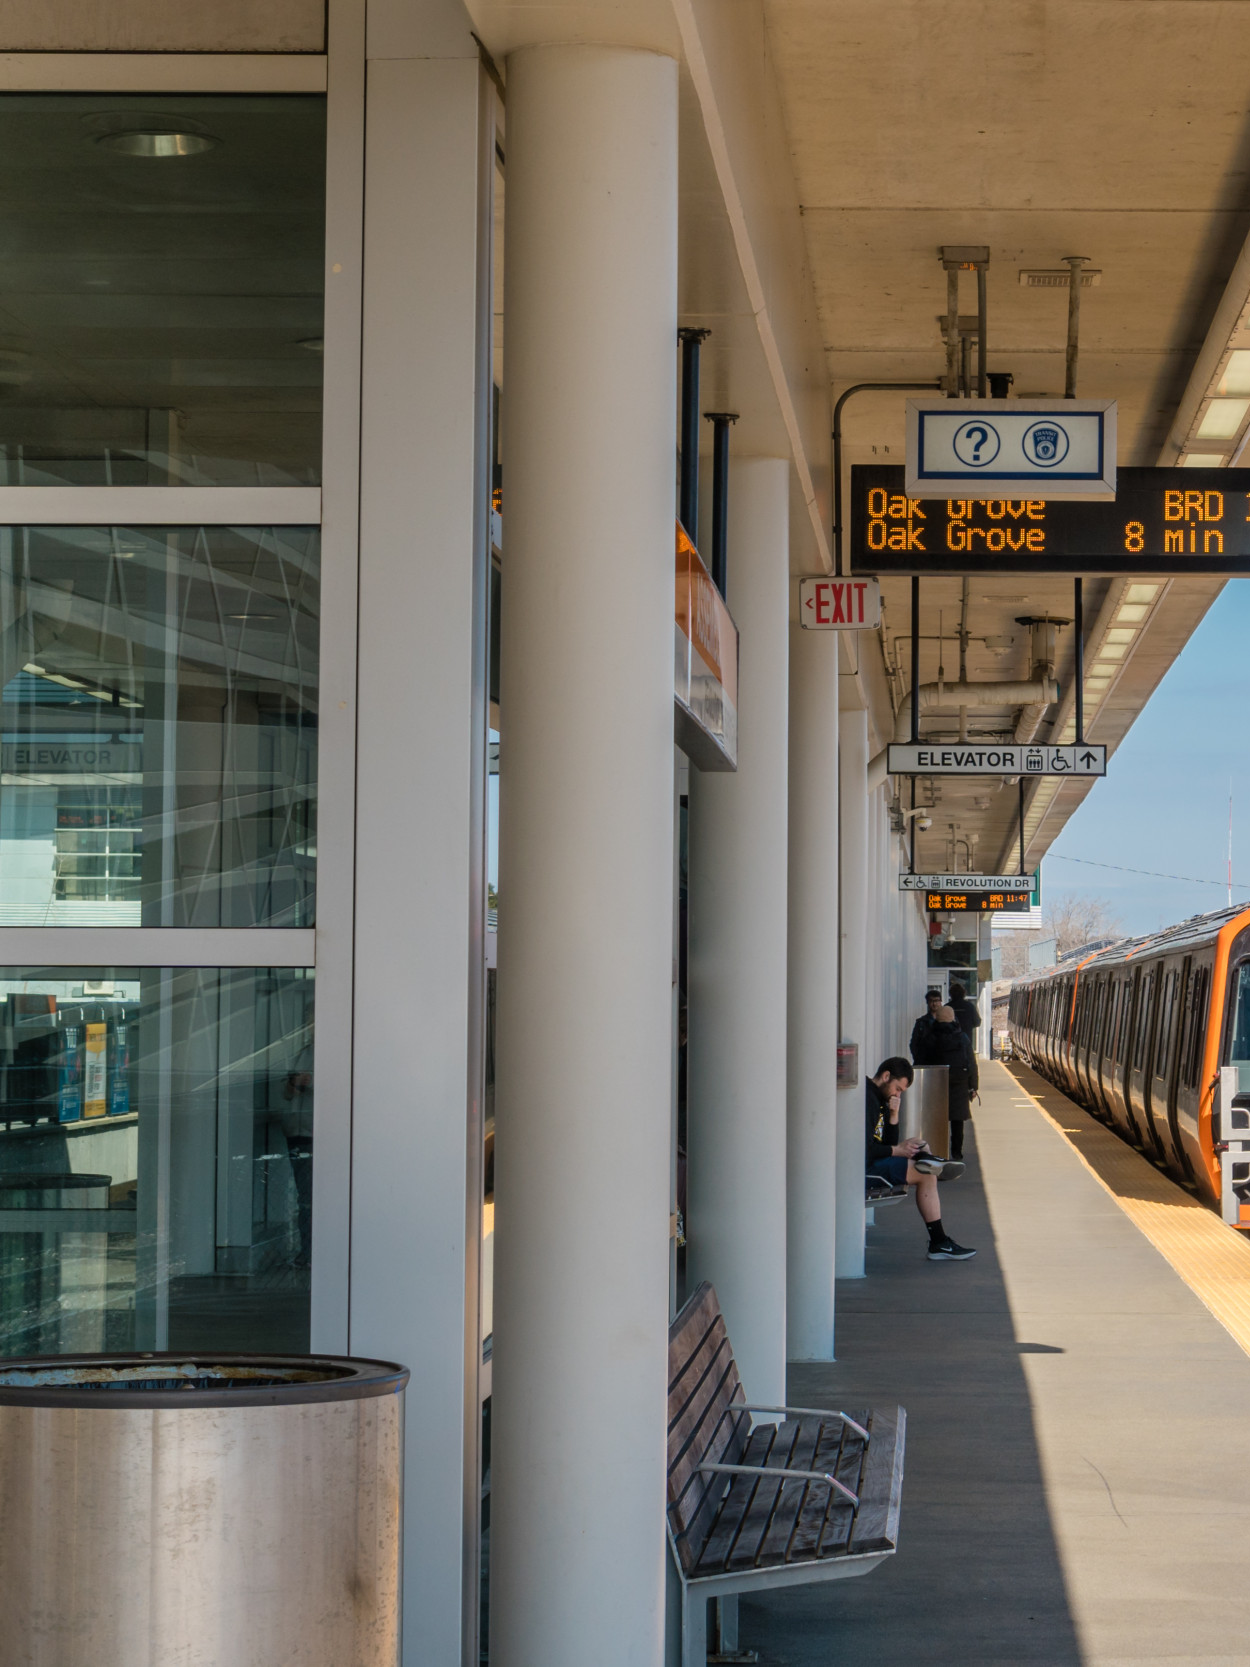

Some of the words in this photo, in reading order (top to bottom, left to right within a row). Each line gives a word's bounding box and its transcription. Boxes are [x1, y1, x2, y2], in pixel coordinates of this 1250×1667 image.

[868, 488, 926, 519] Oak
[947, 499, 1045, 519] Grove
[1165, 491, 1223, 521] BRD
[868, 519, 926, 550] Oak
[947, 520, 1045, 551] Grove
[1125, 522, 1144, 552] 8
[1165, 522, 1223, 552] min
[815, 583, 867, 624] EXIT
[917, 752, 1014, 767] ELEVATOR
[946, 879, 1011, 888] REVOLUTION
[1015, 880, 1030, 888] DR
[990, 901, 1004, 909] min
[1006, 894, 1028, 902] 11:47
